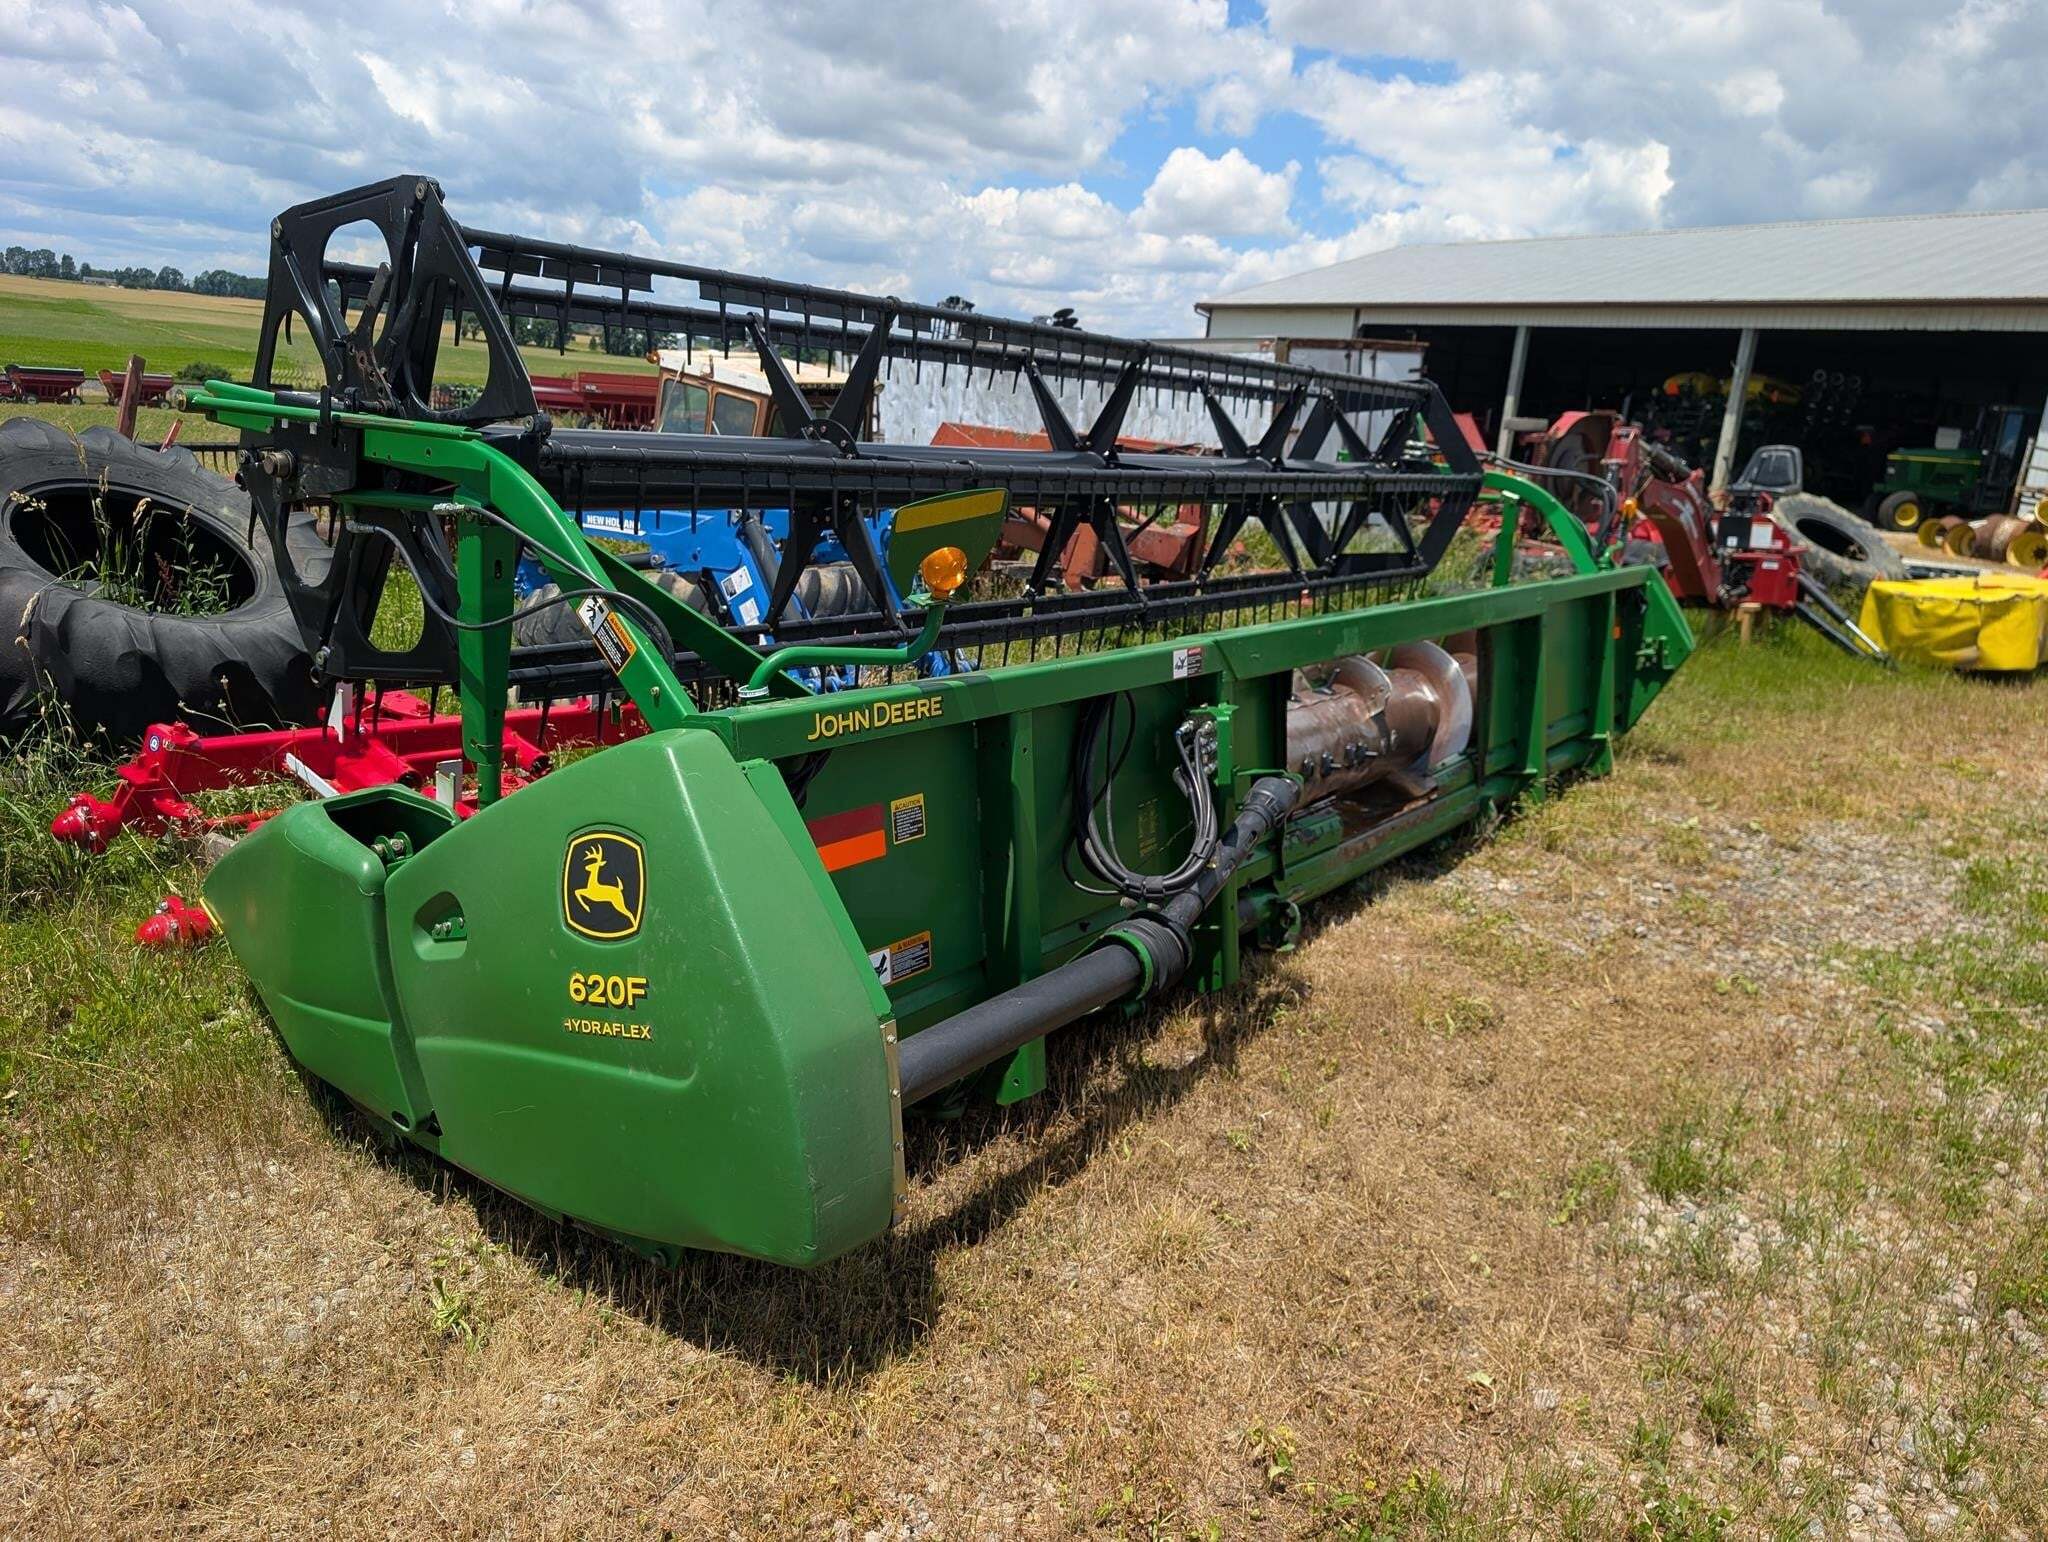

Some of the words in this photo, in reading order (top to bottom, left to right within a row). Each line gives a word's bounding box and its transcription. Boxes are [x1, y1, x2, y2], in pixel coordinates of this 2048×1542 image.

[587, 514, 605, 526] NEW
[606, 516, 640, 529] HOLAN
[808, 709, 870, 740] JOHN
[873, 696, 943, 728] DEERE
[569, 971, 648, 1009] 620F
